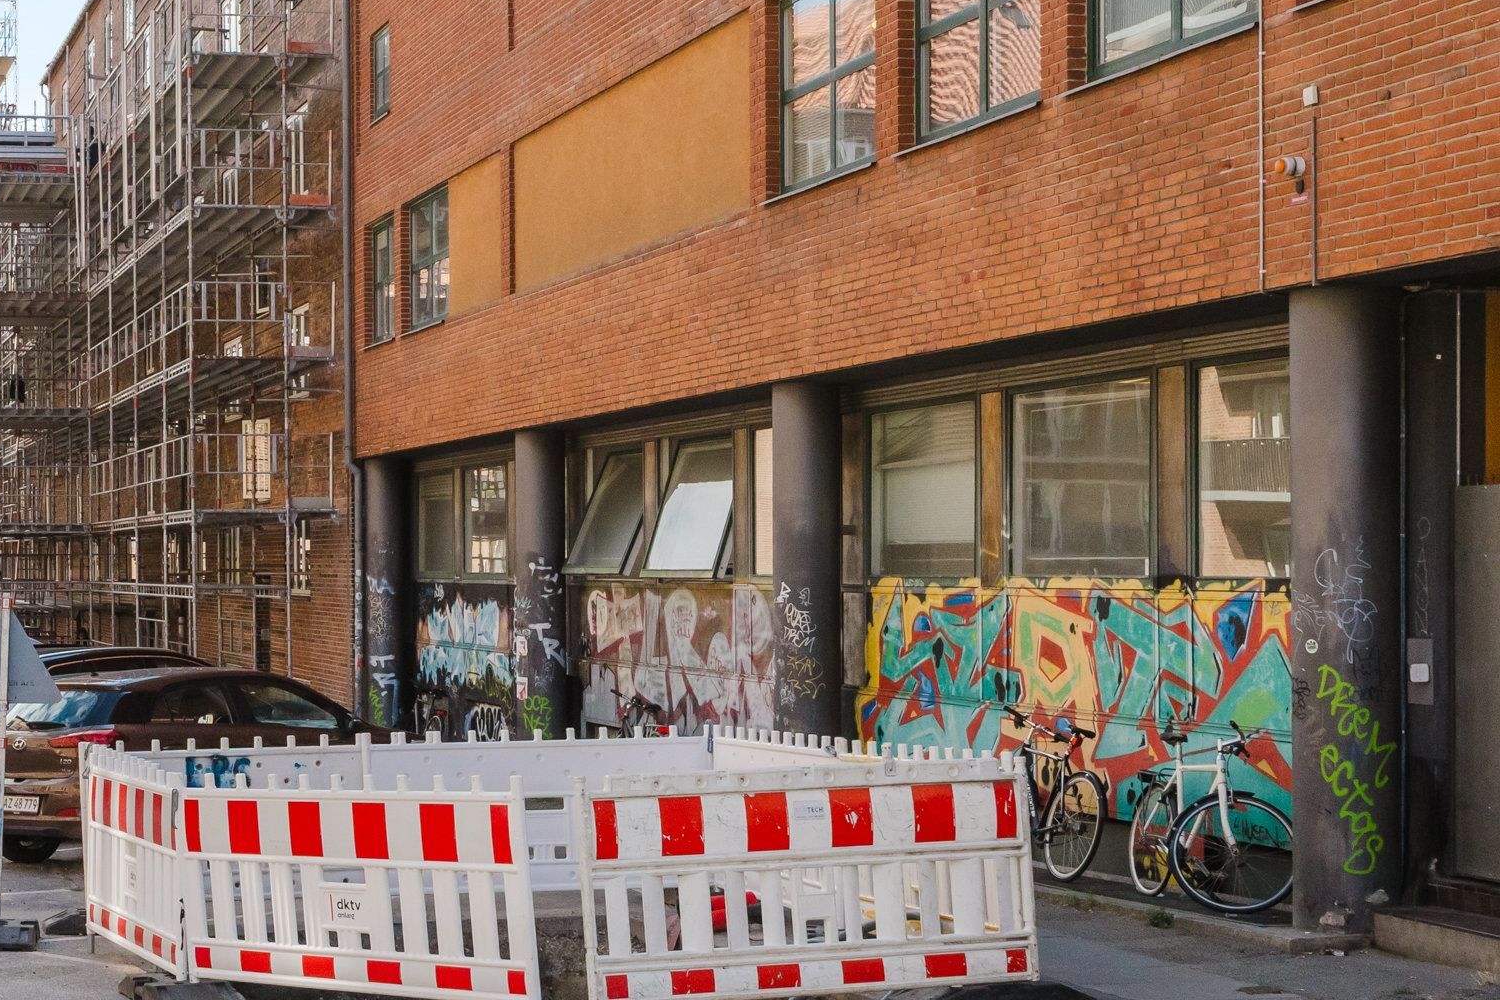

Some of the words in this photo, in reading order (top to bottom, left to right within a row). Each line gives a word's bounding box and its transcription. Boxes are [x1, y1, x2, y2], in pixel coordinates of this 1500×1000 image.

[3, 796, 12, 809] AZ
[14, 796, 23, 809] 48
[24, 798, 38, 812] 779
[336, 898, 361, 911] dktv
